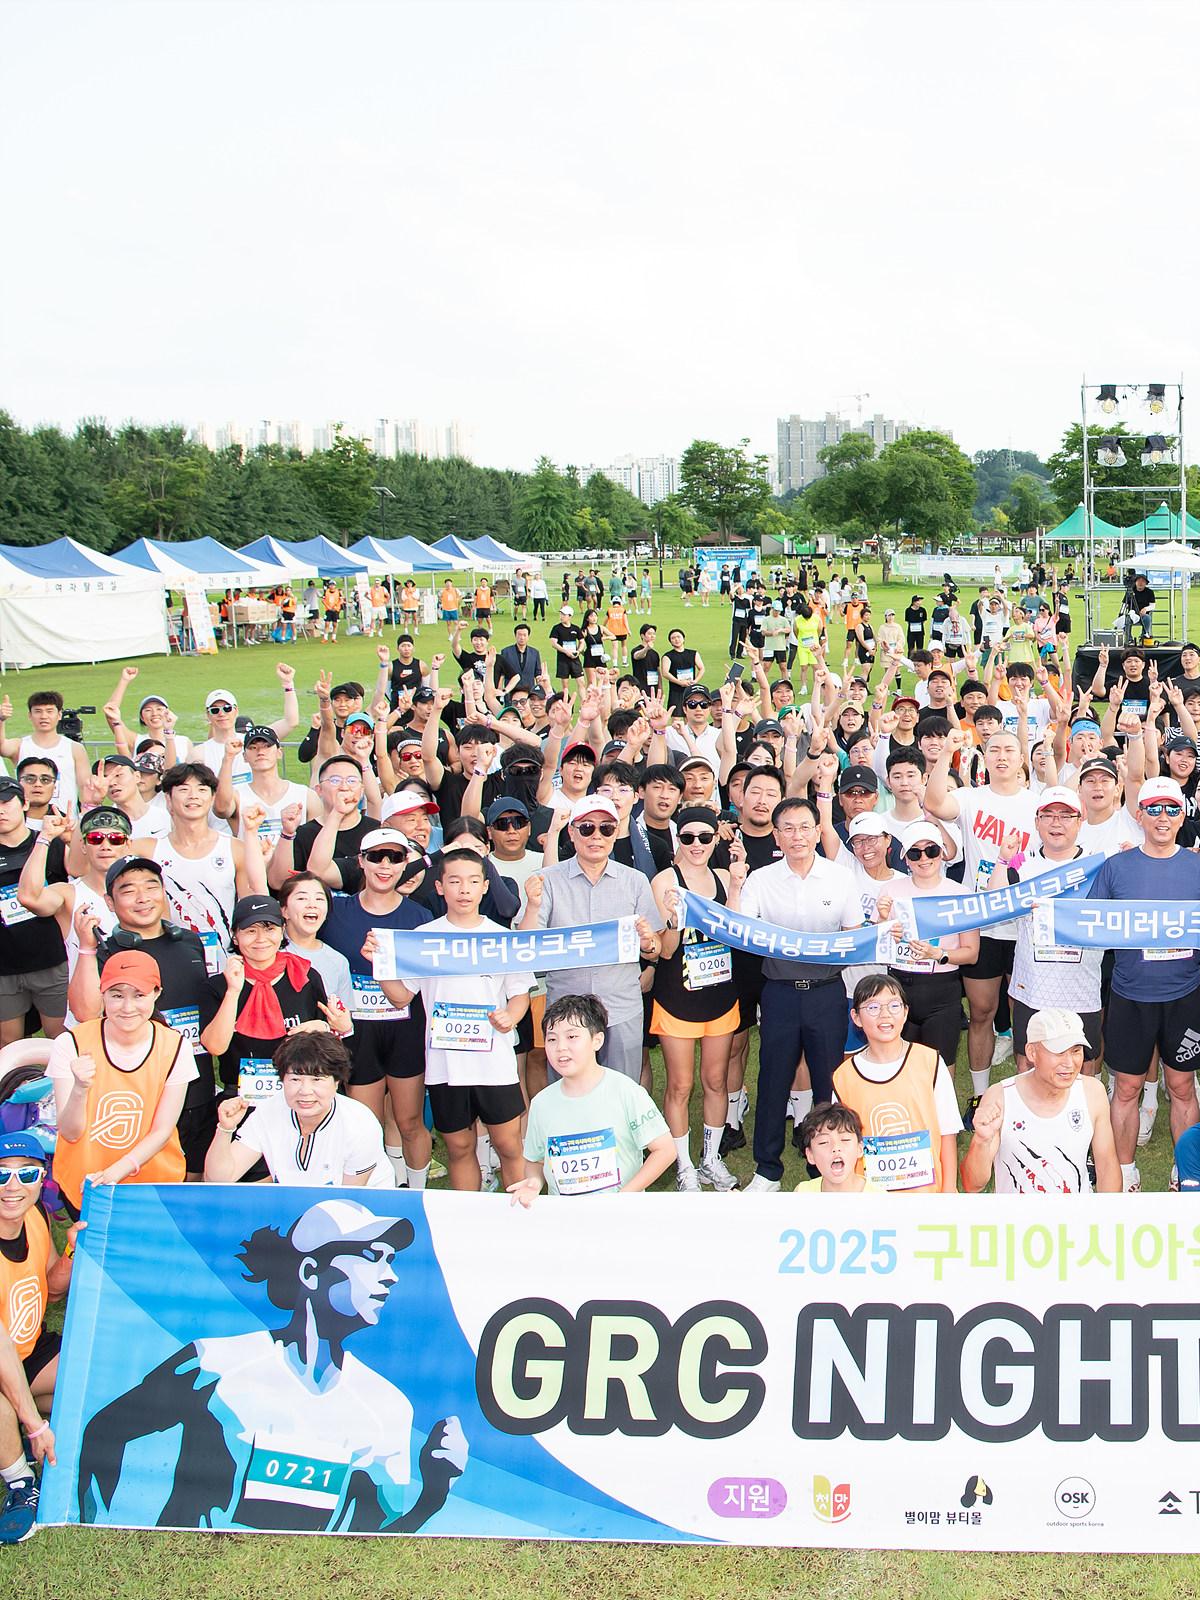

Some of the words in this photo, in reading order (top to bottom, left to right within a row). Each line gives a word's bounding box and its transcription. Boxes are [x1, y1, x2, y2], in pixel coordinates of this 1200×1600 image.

[249, 727, 270, 736] NYC
[937, 867, 1089, 925] 구미러닝크루
[702, 908, 857, 958] 구미러닝크루
[420, 927, 597, 968] 구미러닝크루
[699, 958, 726, 972] 0206
[362, 994, 387, 1005] 002
[445, 1022, 480, 1034] 0025
[255, 1080, 283, 1091] 035
[561, 1156, 600, 1174] 0257
[878, 1156, 918, 1172] 0024
[778, 1229, 897, 1275] 2025
[483, 1305, 760, 1431] GRC
[265, 1458, 333, 1488] 0721
[722, 1484, 771, 1513] 지원
[1061, 1492, 1090, 1504] OSK
[904, 1511, 942, 1525] 별이맘
[945, 1511, 983, 1526] 뷰티몰
[1070, 1521, 1087, 1529] sports
